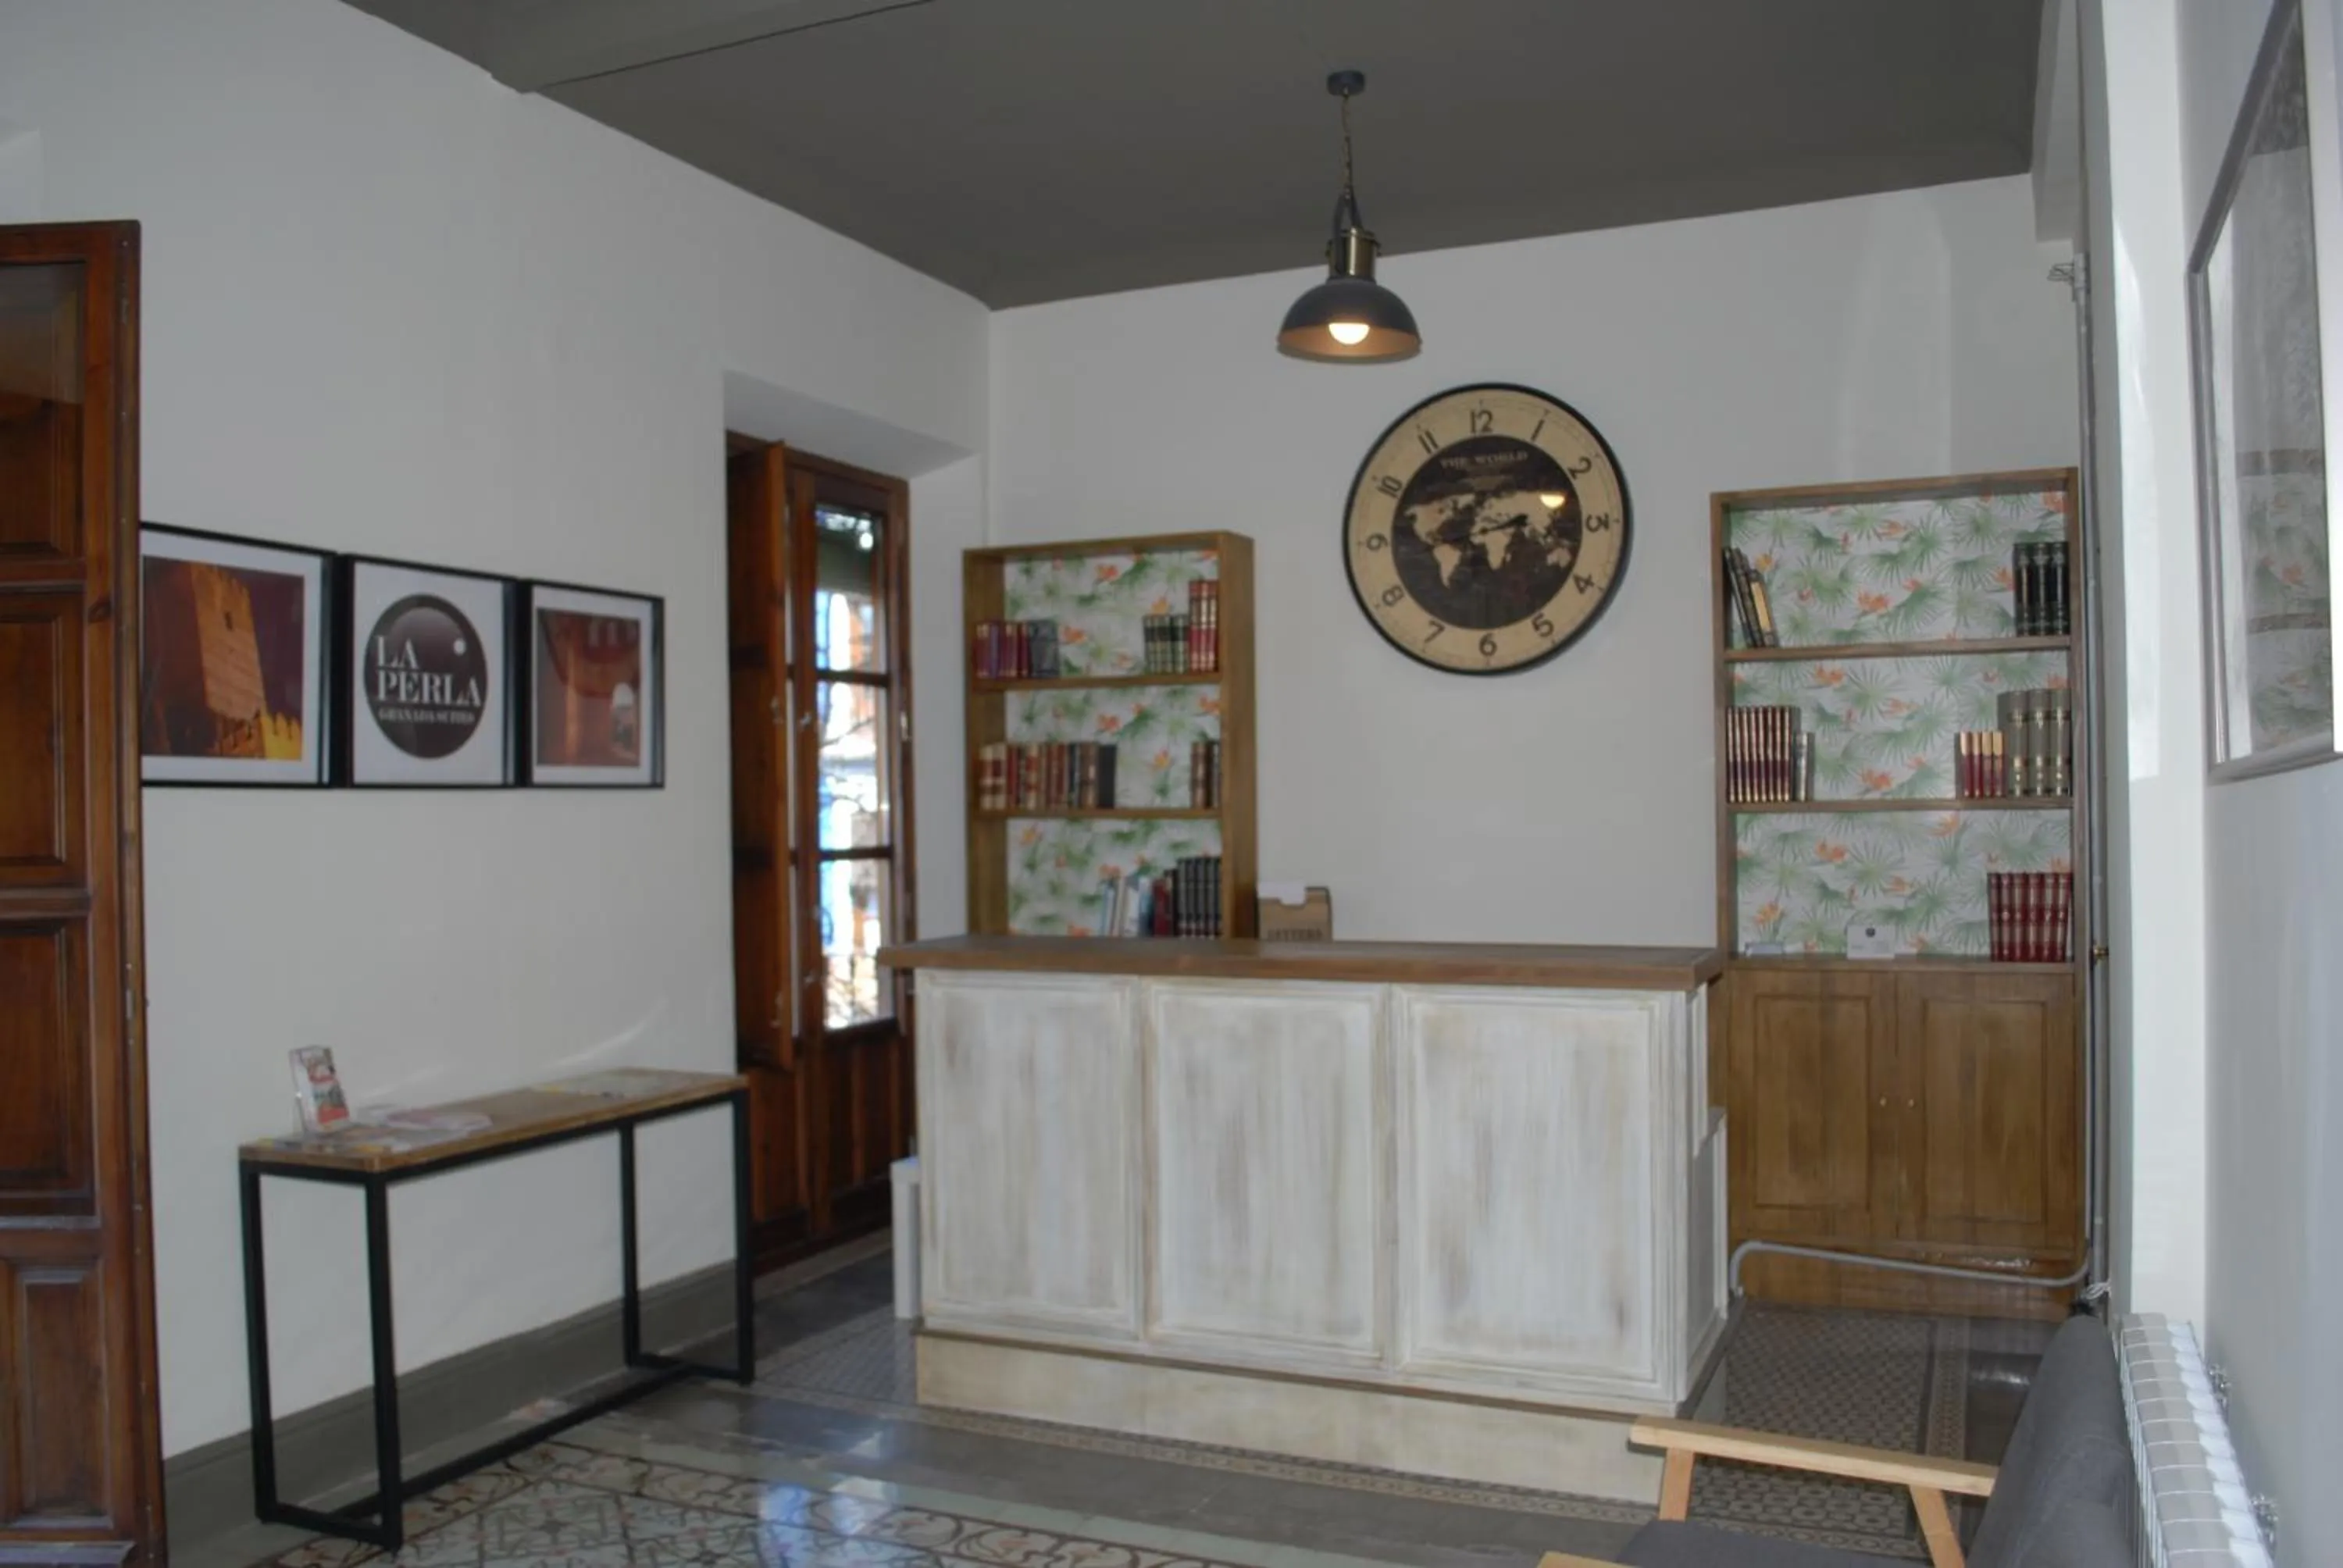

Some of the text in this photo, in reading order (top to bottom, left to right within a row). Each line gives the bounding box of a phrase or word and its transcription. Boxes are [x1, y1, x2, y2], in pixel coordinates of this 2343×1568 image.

[1470, 410, 1493, 433] 12
[1531, 419, 1546, 442] 1
[1418, 430, 1439, 454] 11
[1475, 450, 1528, 466] WORLD
[1567, 456, 1592, 480] 2
[1377, 474, 1403, 499] 10
[1586, 513, 1610, 533] 3
[1367, 533, 1388, 553] 9
[1573, 572, 1595, 595] 4
[1382, 585, 1405, 608] 8
[1424, 620, 1446, 644] 7
[1531, 613, 1554, 637] 5
[377, 636, 419, 670] LA
[1479, 633, 1498, 657] 6
[376, 669, 481, 707] PERLA
